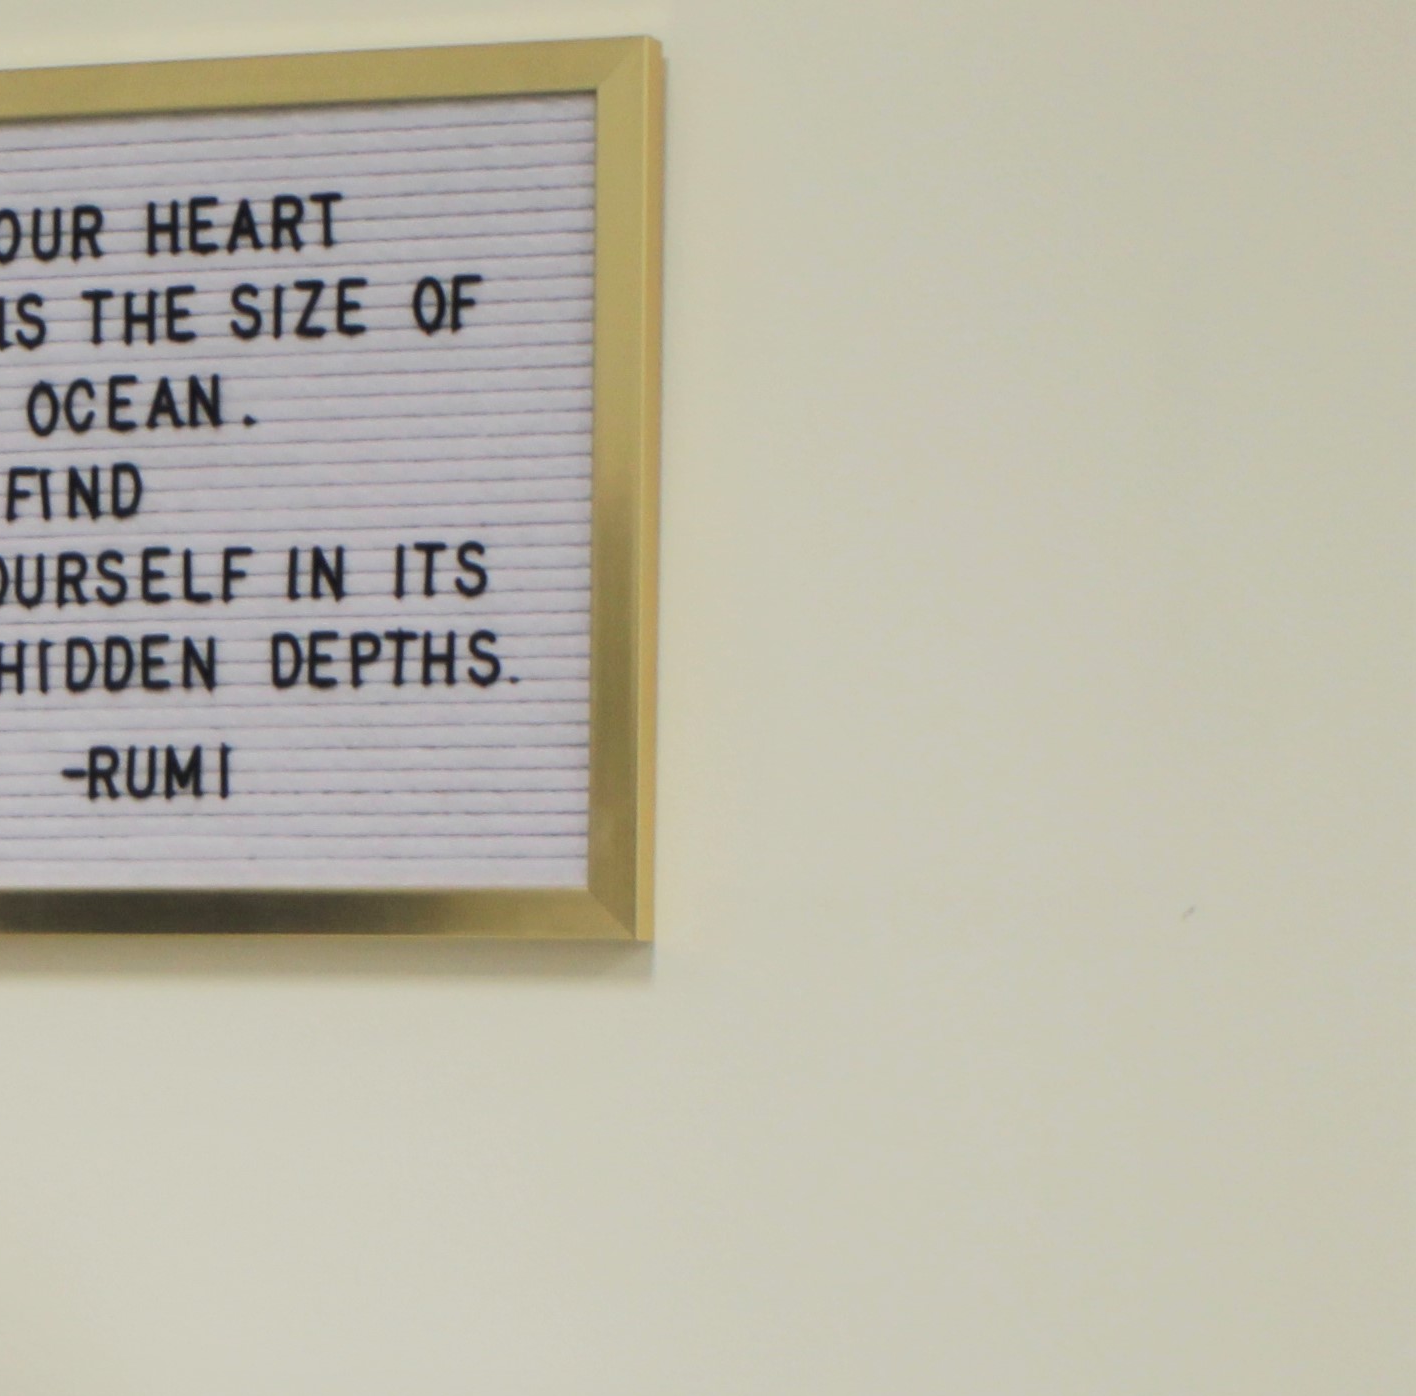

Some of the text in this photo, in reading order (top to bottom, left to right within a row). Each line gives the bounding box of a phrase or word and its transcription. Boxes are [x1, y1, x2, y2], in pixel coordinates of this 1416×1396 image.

[146, 192, 343, 257] HEART
[81, 285, 197, 346] THE
[230, 278, 368, 341] SIZE
[411, 274, 483, 336] OF
[26, 374, 257, 437] OCEAN.
[5, 462, 143, 522] FIND
[287, 546, 347, 602] IN
[393, 541, 488, 599] ITS
[271, 629, 519, 690] DEPTHS.
[62, 744, 231, 800] -RUMI
